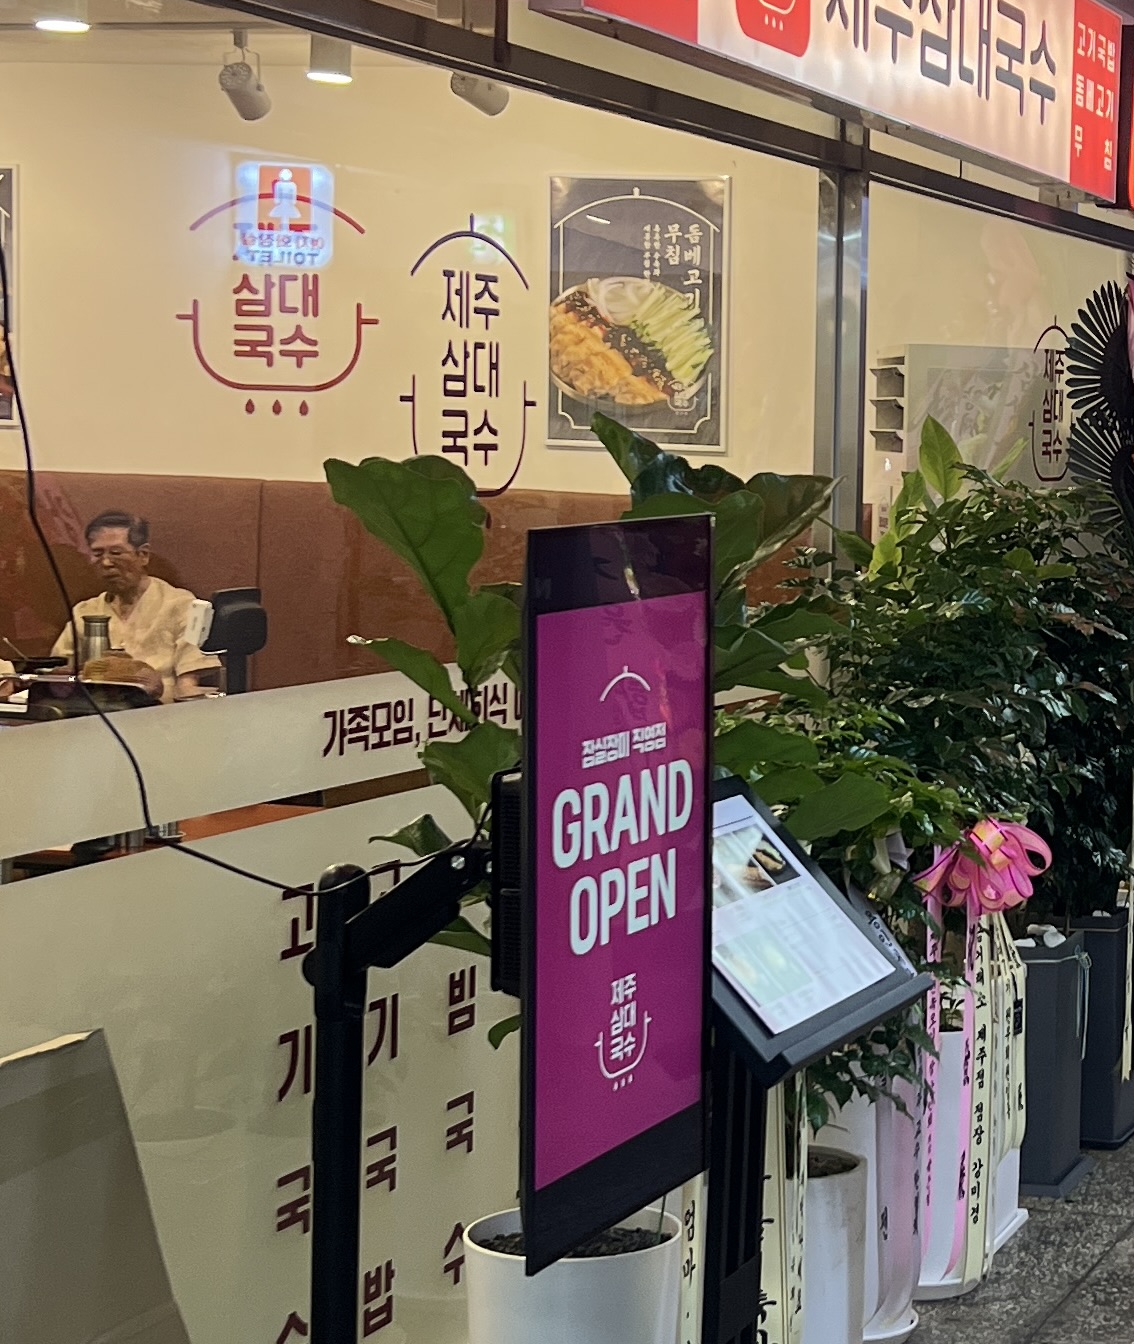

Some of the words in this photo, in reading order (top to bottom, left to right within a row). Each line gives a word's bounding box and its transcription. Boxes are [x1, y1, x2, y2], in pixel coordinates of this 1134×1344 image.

[1077, 21, 1116, 73] 고기국밥
[664, 223, 682, 266] 무침
[683, 223, 704, 312] 돔베고기
[233, 273, 319, 318] 삼대
[441, 268, 500, 331] 제주
[234, 324, 320, 368] 국수
[441, 340, 500, 399] 삼대
[1043, 349, 1066, 383] 제주
[1042, 388, 1064, 424] 삼대
[441, 409, 500, 467] 국수
[1041, 429, 1064, 464] 국수
[323, 697, 421, 757] 가족모임,
[582, 731, 630, 769] 잠실장미
[632, 722, 667, 753] 직영점
[552, 759, 693, 869] GRAND
[570, 848, 676, 955] OPEN
[611, 973, 637, 1005] 제주
[611, 1000, 637, 1036] 삼대
[610, 1035, 637, 1061] 국수
[976, 1023, 988, 1089] 제주점
[973, 1102, 985, 1146] 점장
[683, 1200, 696, 1288] 엄마
